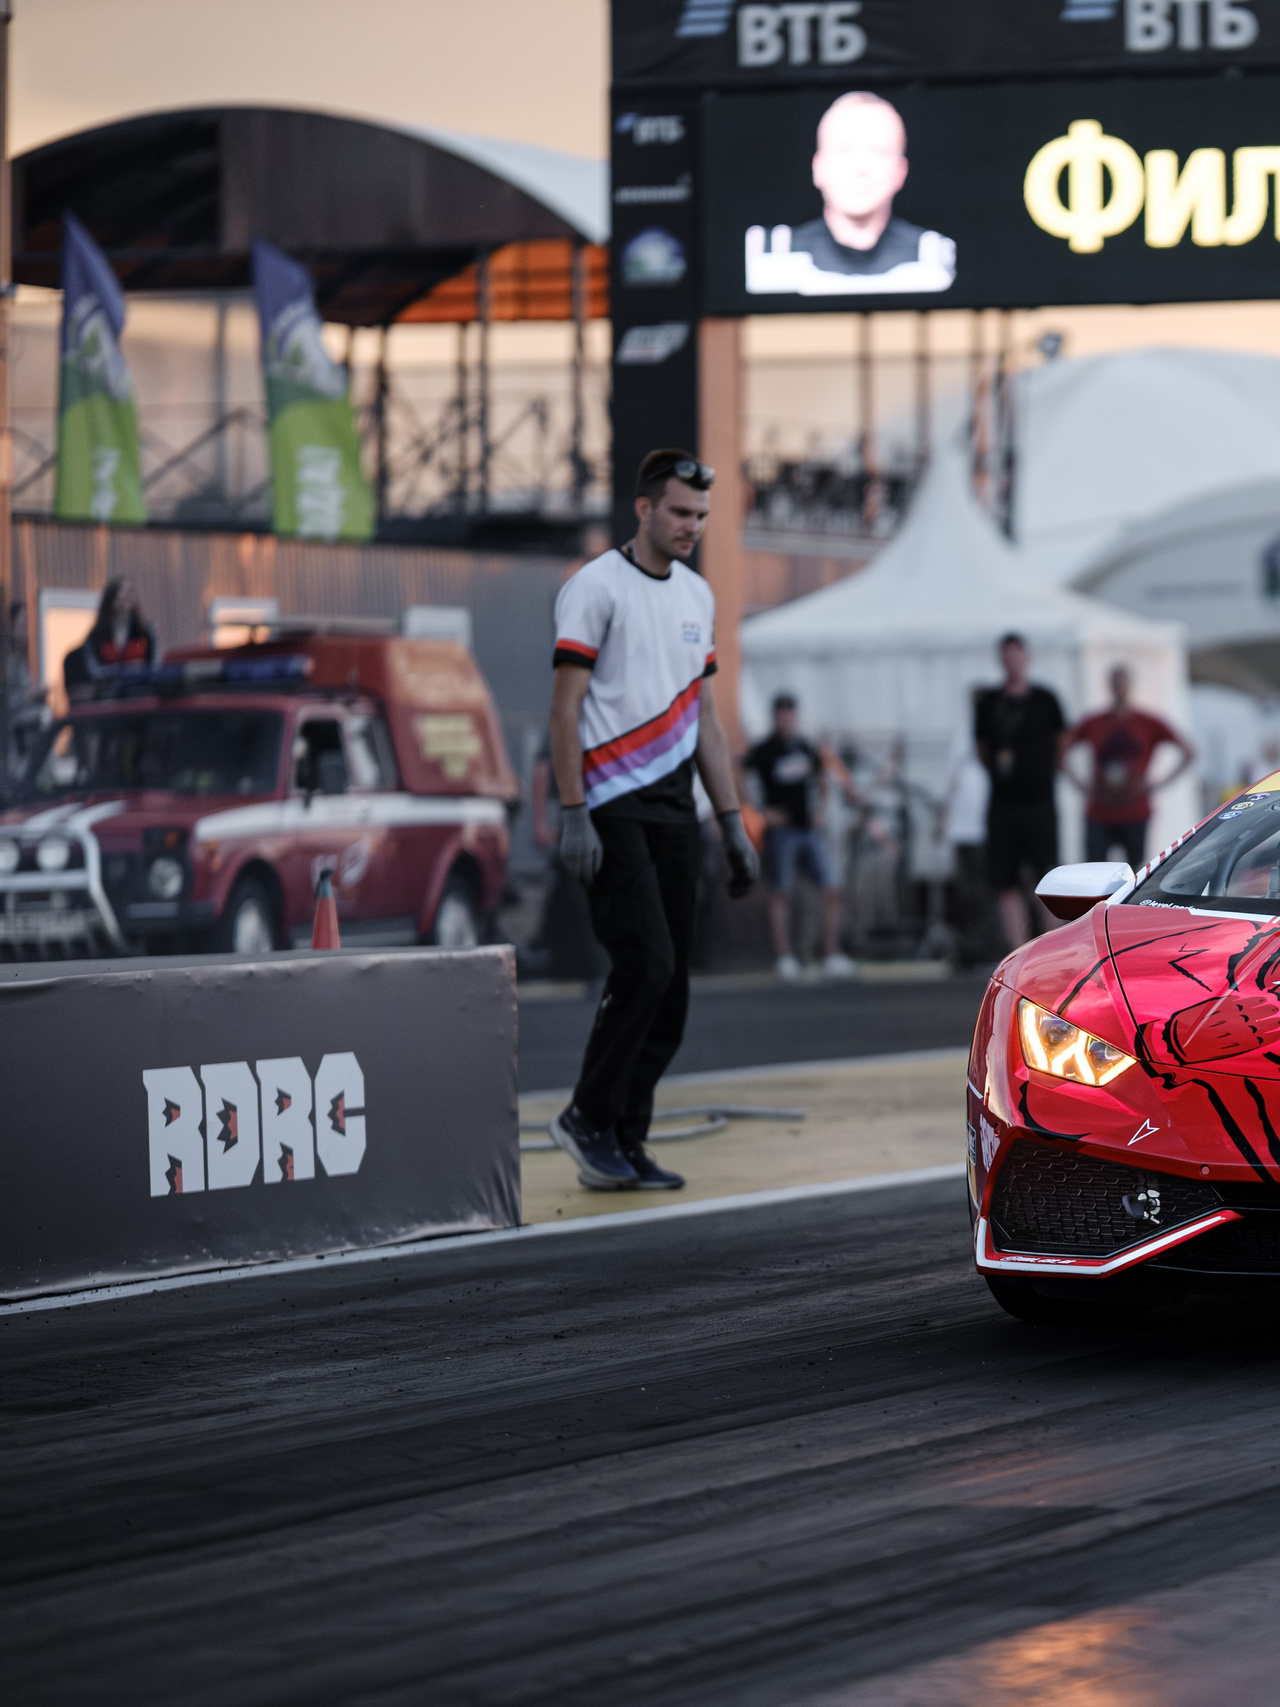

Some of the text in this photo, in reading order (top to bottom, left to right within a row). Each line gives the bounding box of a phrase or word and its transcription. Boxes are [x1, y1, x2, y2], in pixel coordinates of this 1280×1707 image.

[737, 2, 867, 66] ВТБ
[1125, 0, 1260, 52] ВТБ
[142, 1051, 366, 1197] RDRC
